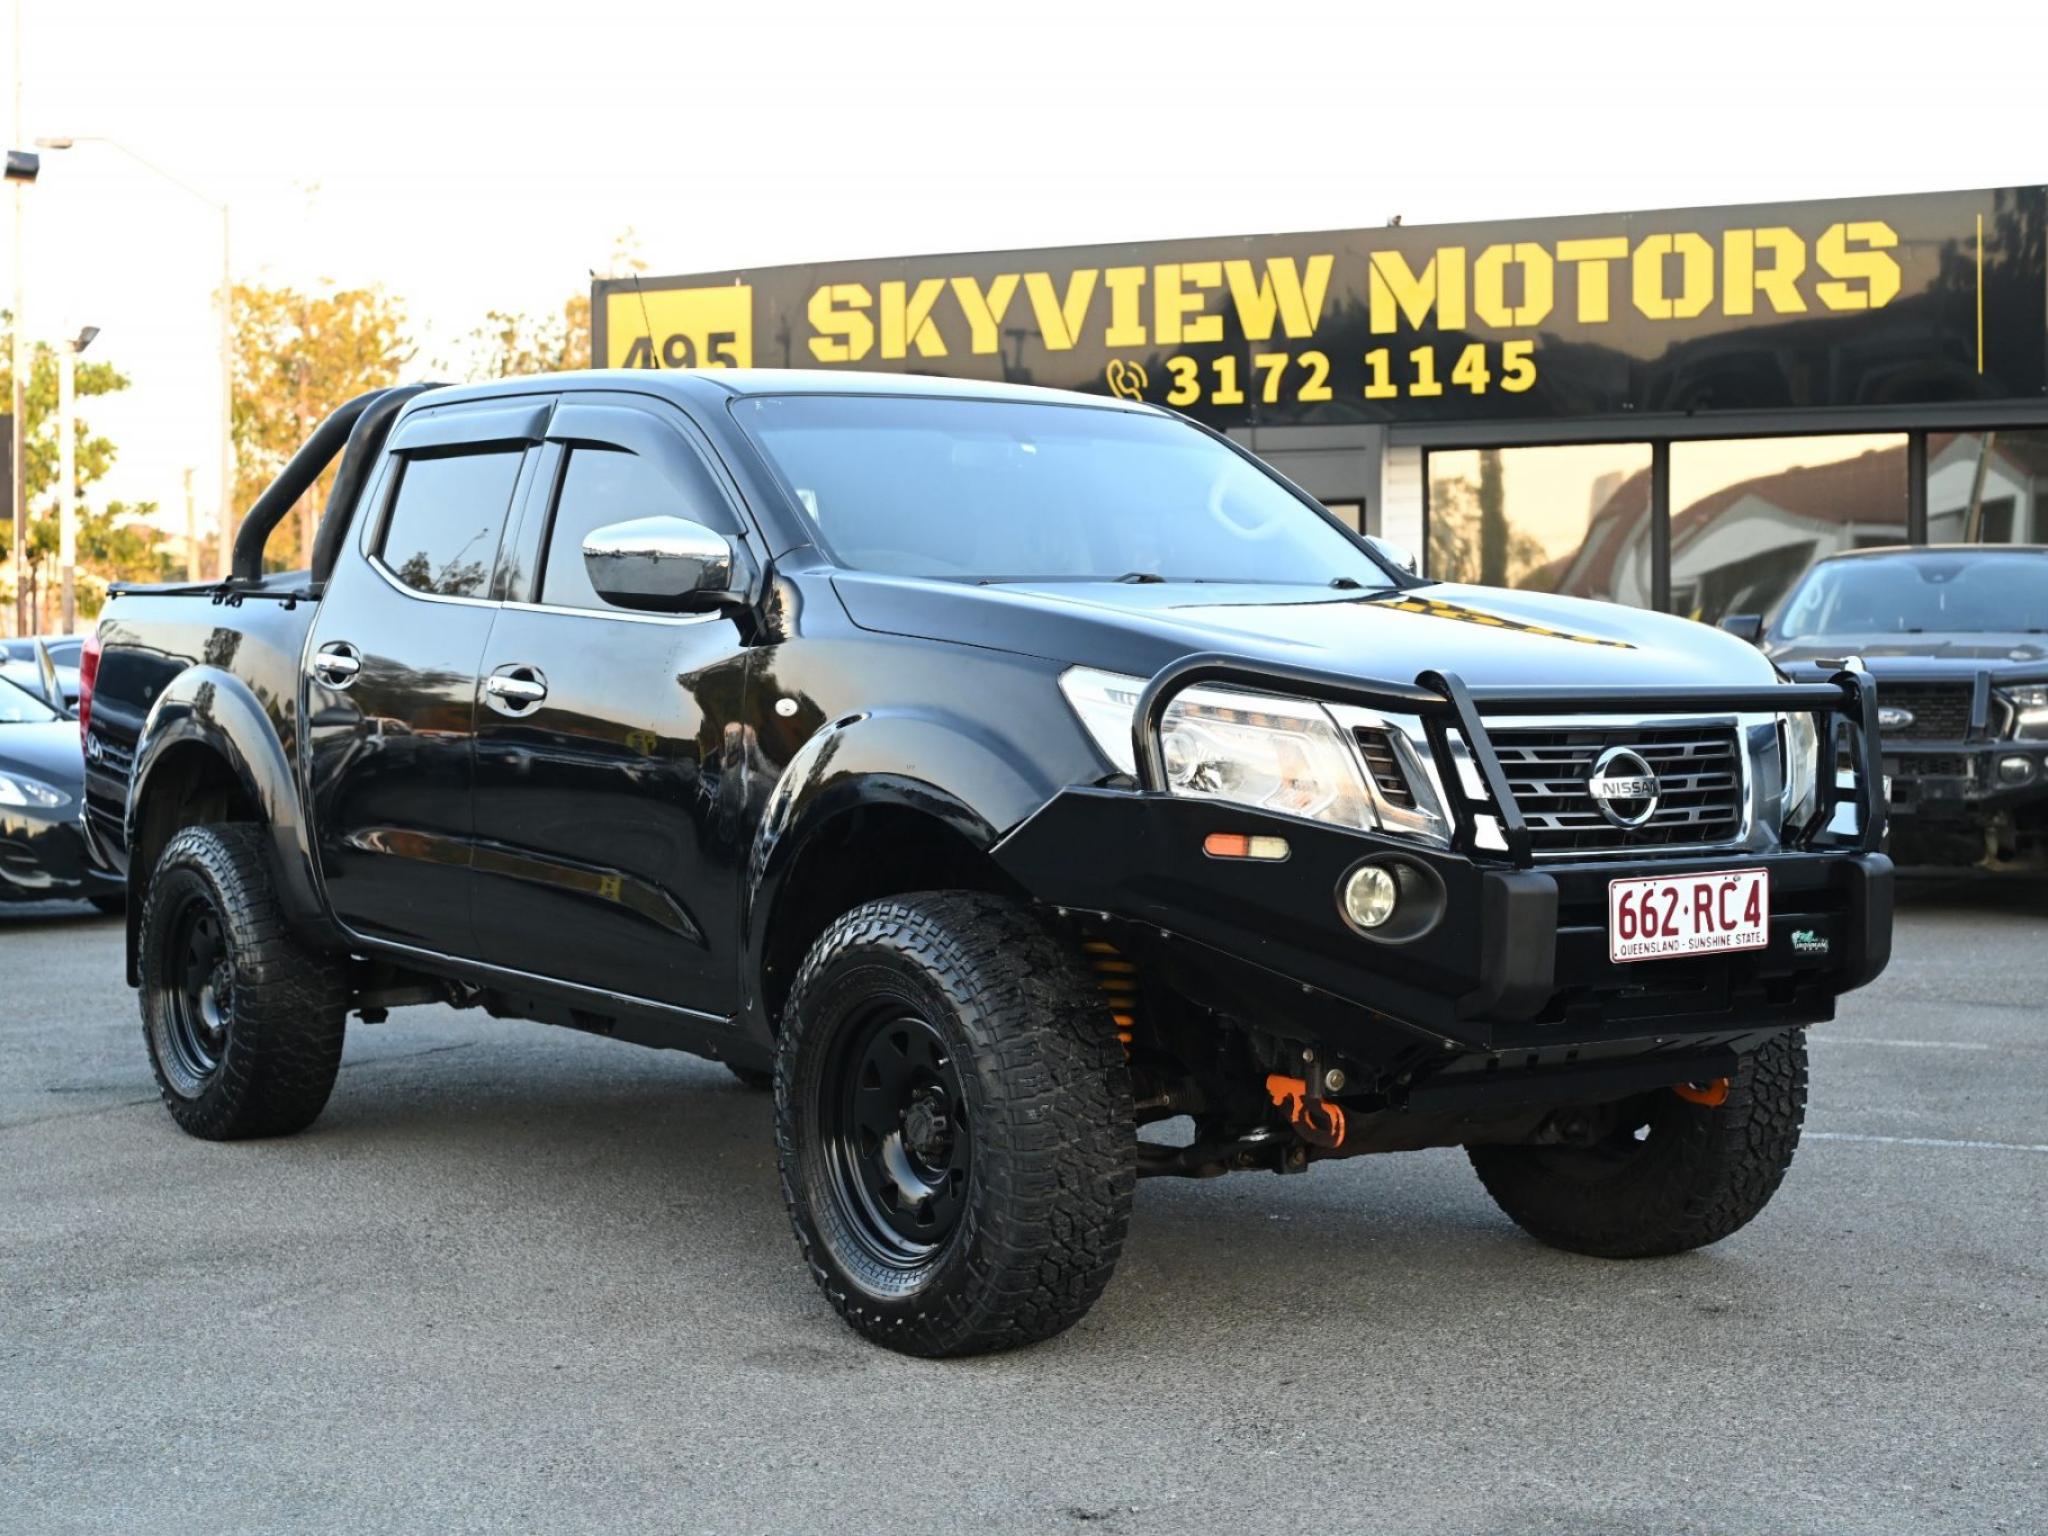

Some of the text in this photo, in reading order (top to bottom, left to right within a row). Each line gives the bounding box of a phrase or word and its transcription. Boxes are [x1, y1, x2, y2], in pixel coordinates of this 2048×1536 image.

[809, 221, 1901, 361] SKYVIEW MOTORS
[1166, 340, 1537, 406] 3172 1145
[1620, 941, 1680, 956] QUEENSLAND
[1688, 935, 1732, 950] SUNSHINE
[1735, 932, 1761, 945] STATE
